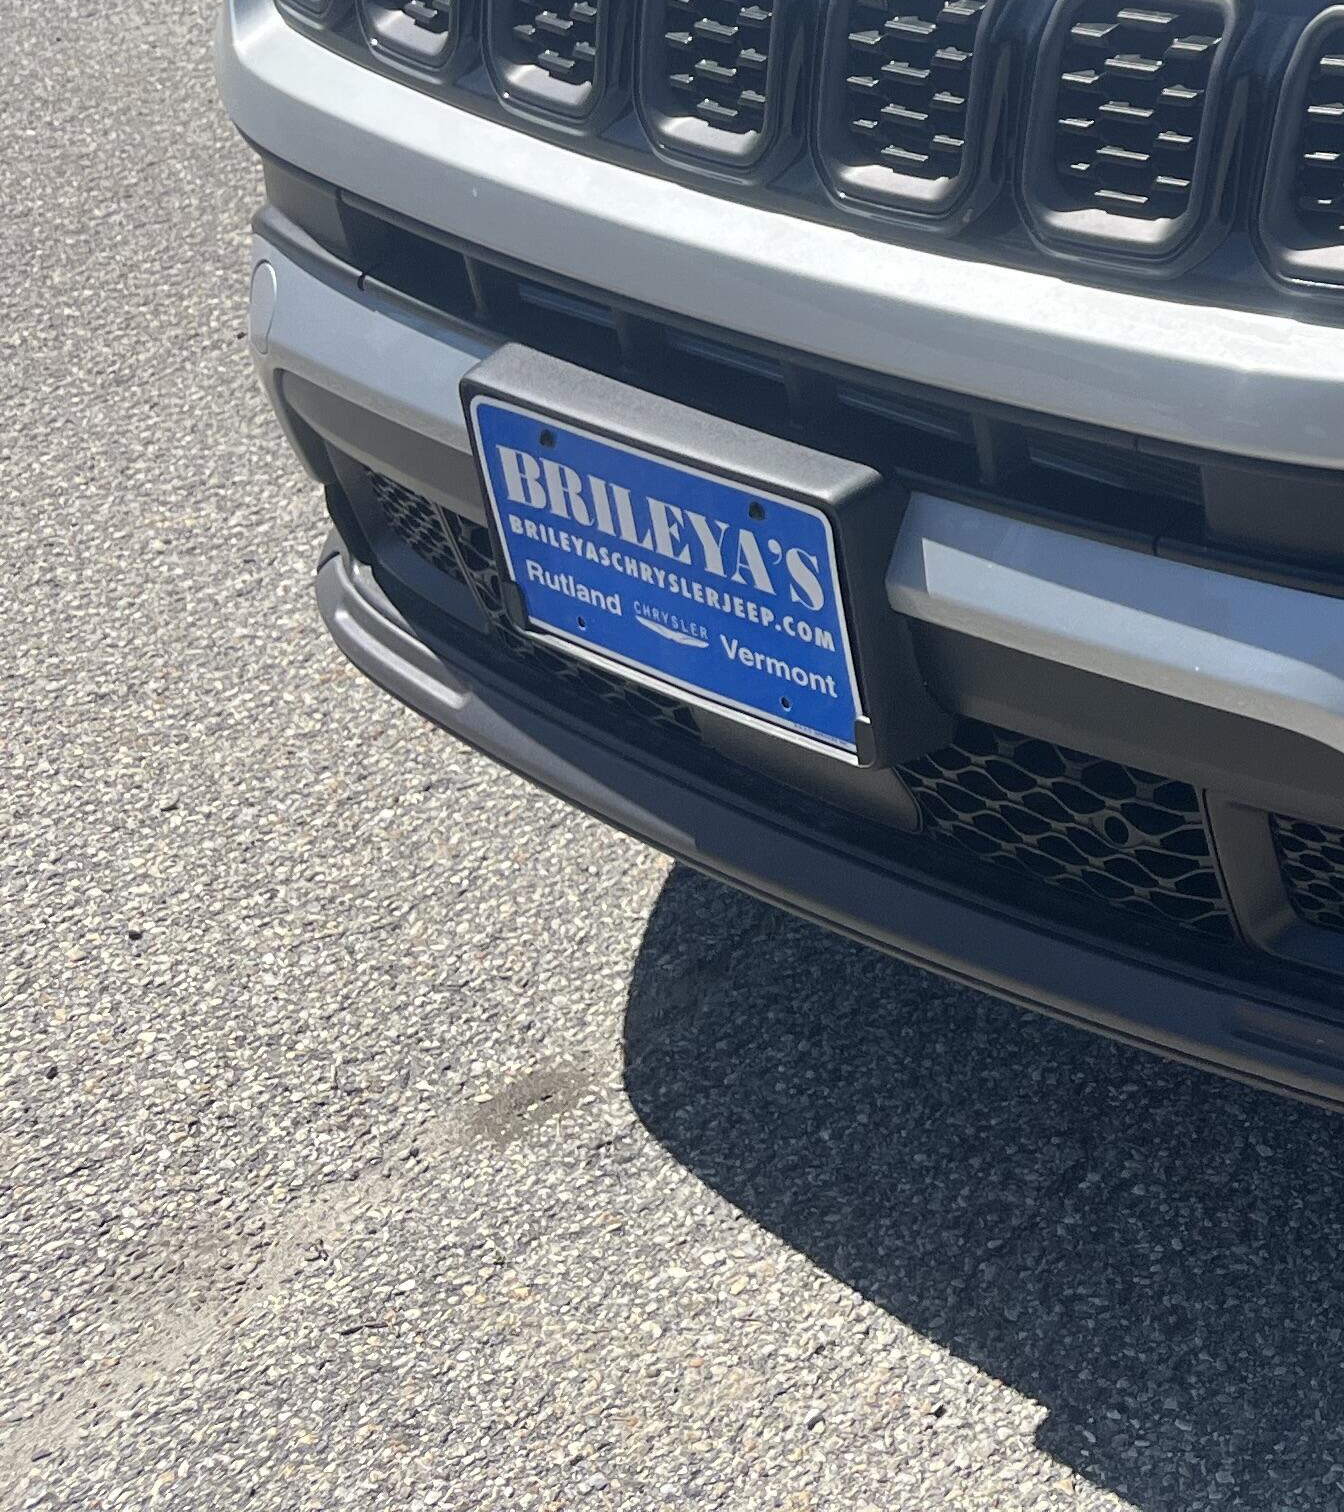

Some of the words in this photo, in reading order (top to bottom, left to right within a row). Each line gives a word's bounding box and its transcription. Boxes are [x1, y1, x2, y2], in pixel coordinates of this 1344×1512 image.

[496, 444, 826, 612] BRILEYA'S
[509, 514, 836, 652] BRILEYASCHRYSLERJEEP.COM
[526, 559, 622, 616] Rutland
[633, 599, 710, 641] CHRYSLER
[720, 634, 838, 698] Vermont
